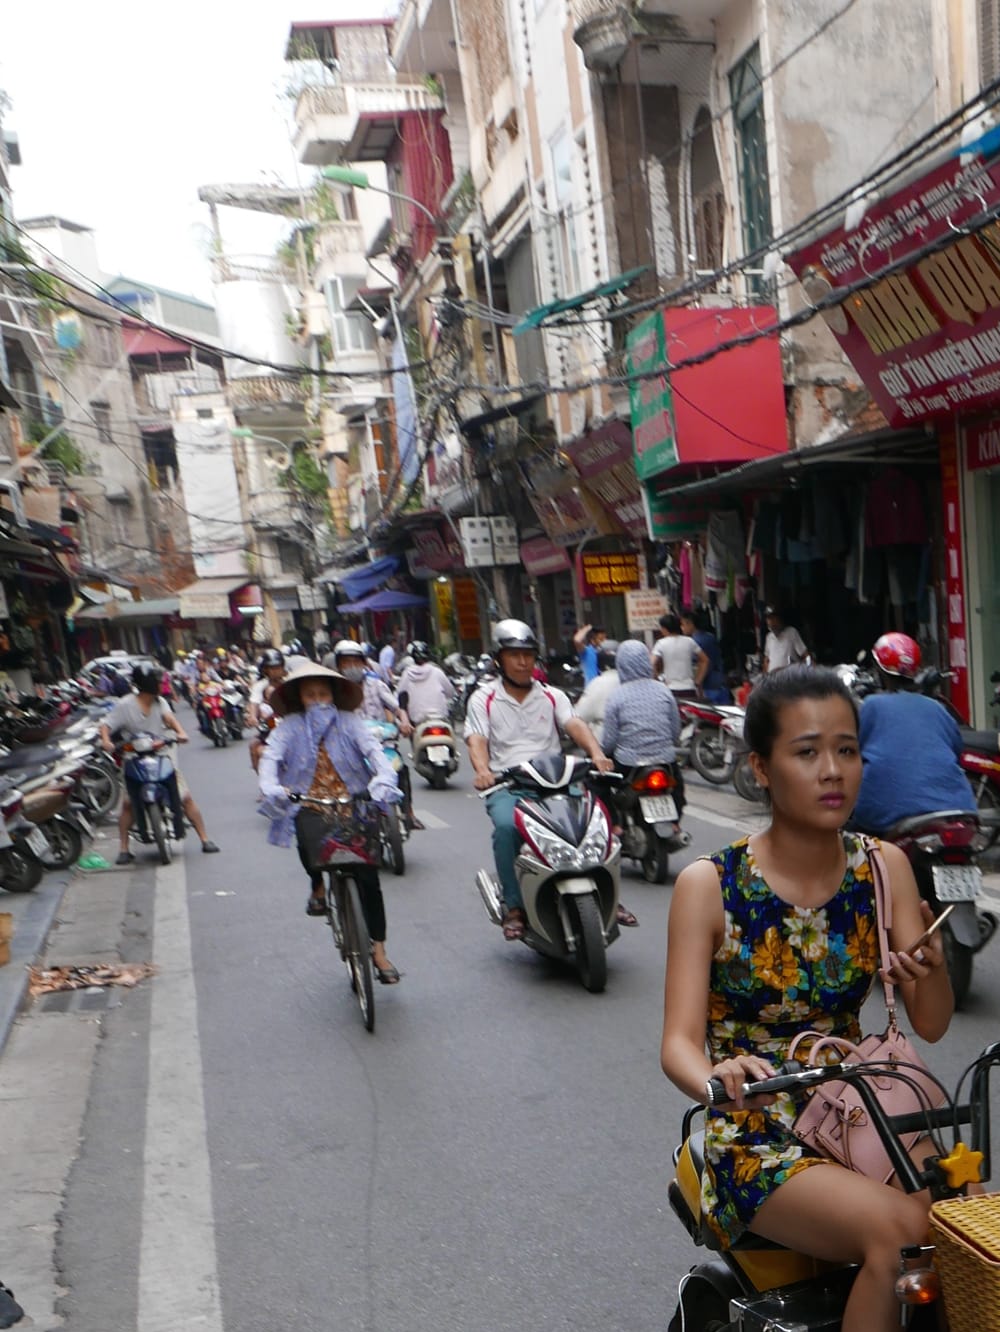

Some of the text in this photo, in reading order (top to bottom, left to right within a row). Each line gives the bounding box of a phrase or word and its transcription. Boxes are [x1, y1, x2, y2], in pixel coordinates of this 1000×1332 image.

[850, 266, 943, 356] MINH
[878, 361, 911, 398] GIỮ
[903, 354, 937, 389] TÍN
[924, 337, 977, 380] NHIỆM
